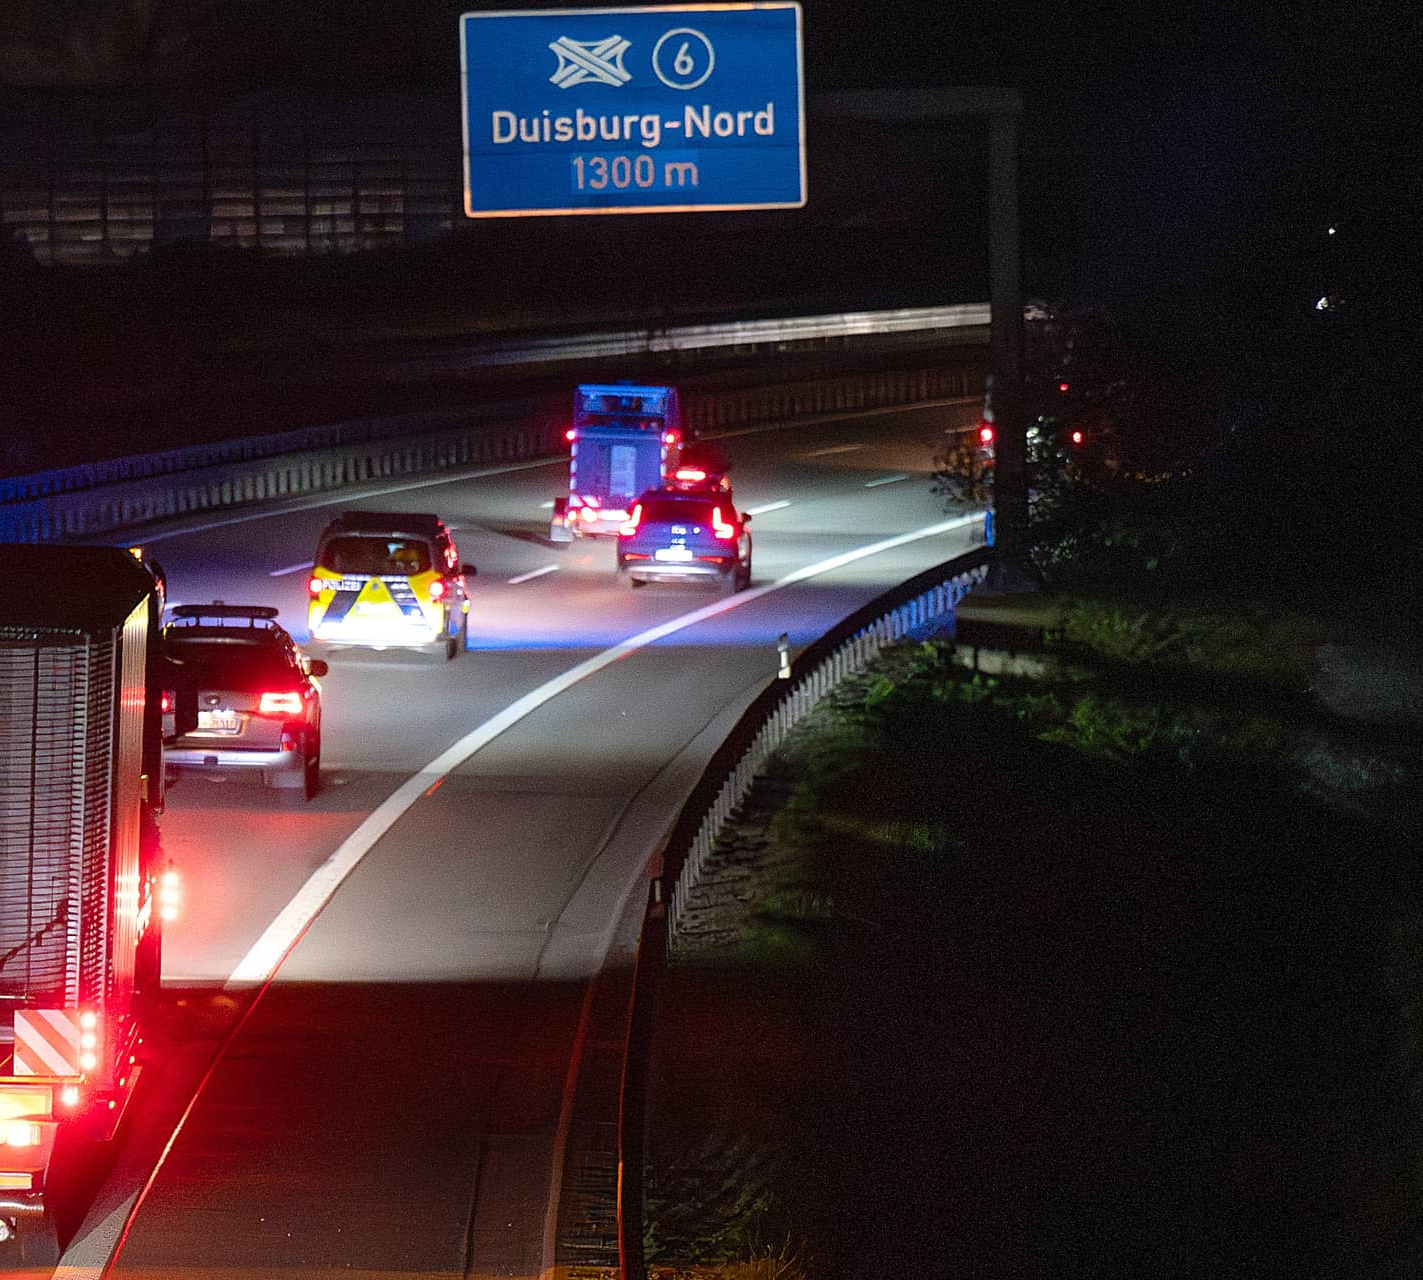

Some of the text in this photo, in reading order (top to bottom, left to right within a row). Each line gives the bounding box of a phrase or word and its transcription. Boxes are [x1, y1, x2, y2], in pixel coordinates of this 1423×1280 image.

[673, 43, 694, 76] 6
[492, 102, 775, 148] Duisburg-Nord
[573, 155, 699, 190] 1300 m
